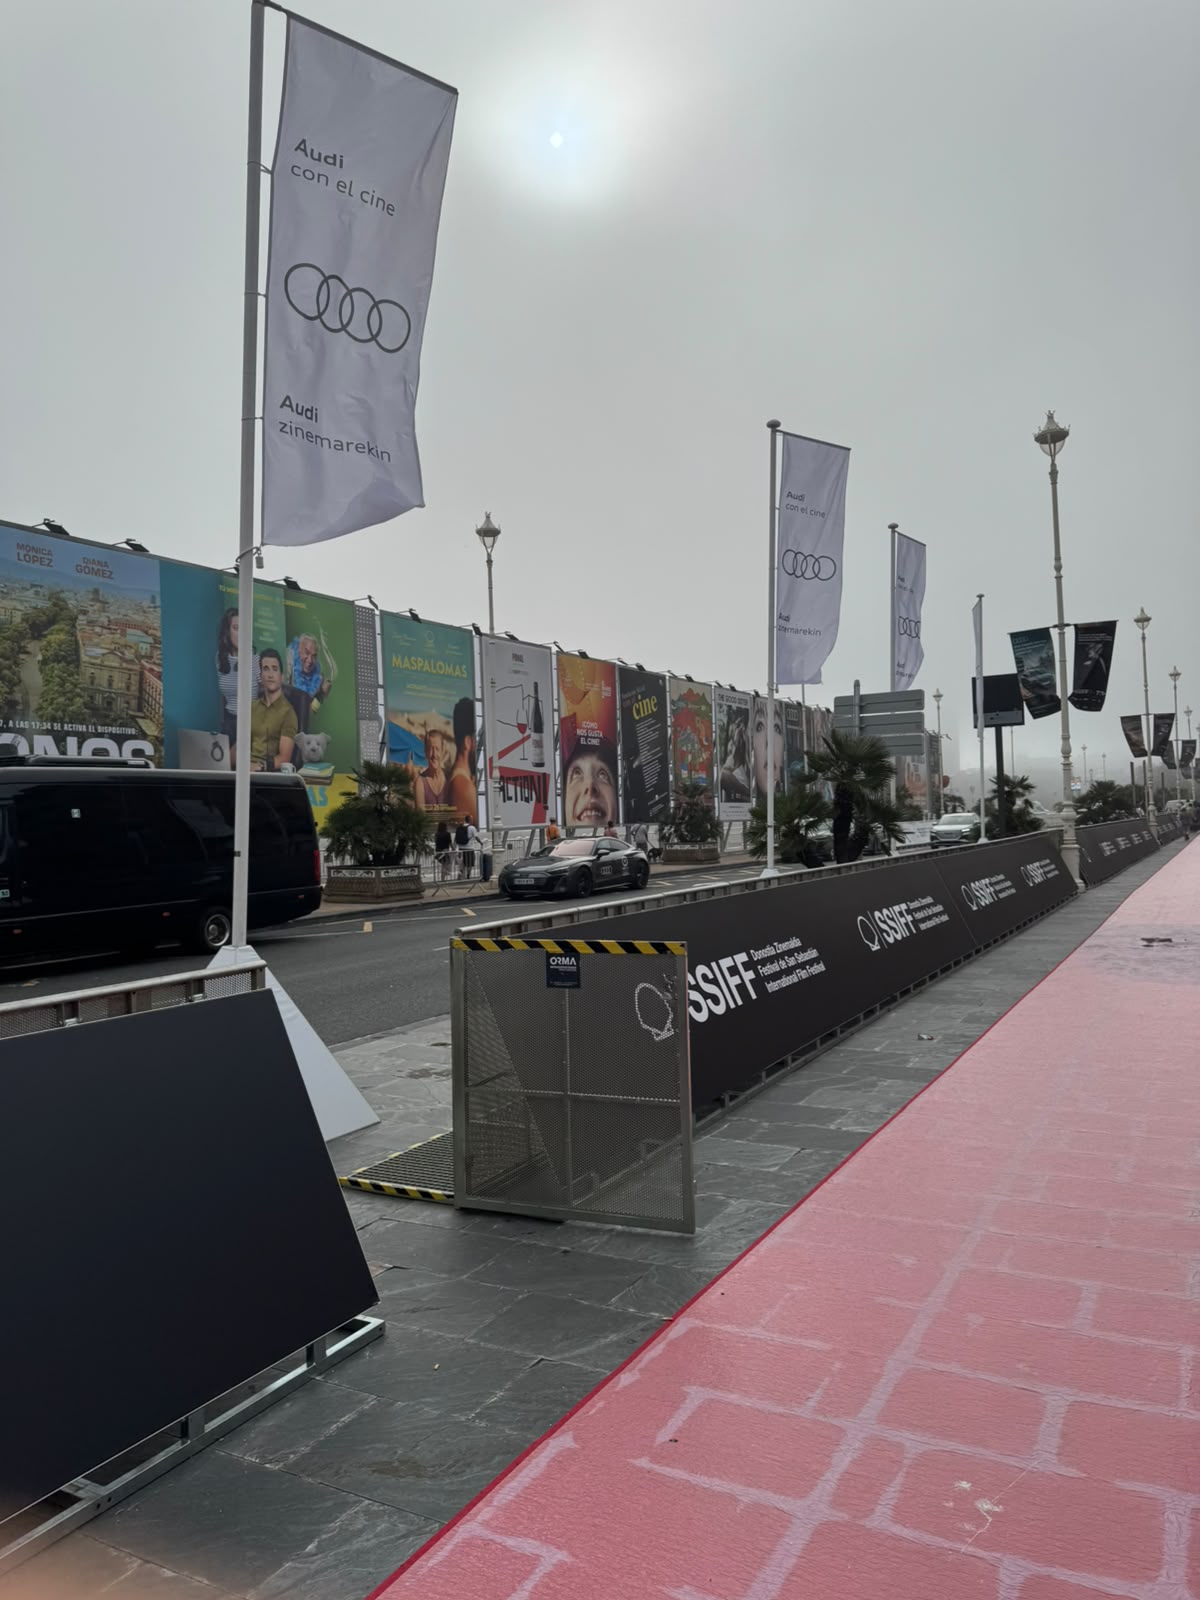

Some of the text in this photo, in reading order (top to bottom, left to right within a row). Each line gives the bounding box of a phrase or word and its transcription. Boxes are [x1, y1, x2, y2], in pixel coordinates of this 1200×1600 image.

[294, 138, 344, 169] Audi
[290, 163, 396, 217] con el cine
[279, 394, 319, 424] Audi
[278, 420, 392, 463] zinemarekin
[786, 490, 806, 502] Audi
[785, 502, 826, 519] con el cine
[82, 557, 110, 568] DIANA
[391, 654, 468, 679] MASPALOMAS
[632, 693, 658, 720] cine
[8, 720, 13, 728] A
[16, 720, 29, 729] LAS
[32, 721, 51, 730] 17:34
[53, 723, 62, 731] SE
[63, 723, 87, 732] ACTIVA
[88, 724, 96, 732] EL
[97, 725, 139, 736] DISPOSITIVO:
[576, 728, 603, 738] NOS GUSTA
[580, 737, 587, 745] EL
[970, 878, 998, 907] SSIFF
[874, 902, 917, 944] SSIFF
[549, 956, 577, 966] ORMA
[750, 936, 803, 961] Donostia Zinemaldia
[757, 959, 780, 977] Festival
[779, 958, 788, 970] de
[784, 954, 798, 967] San
[764, 960, 826, 993] International Film Festival
